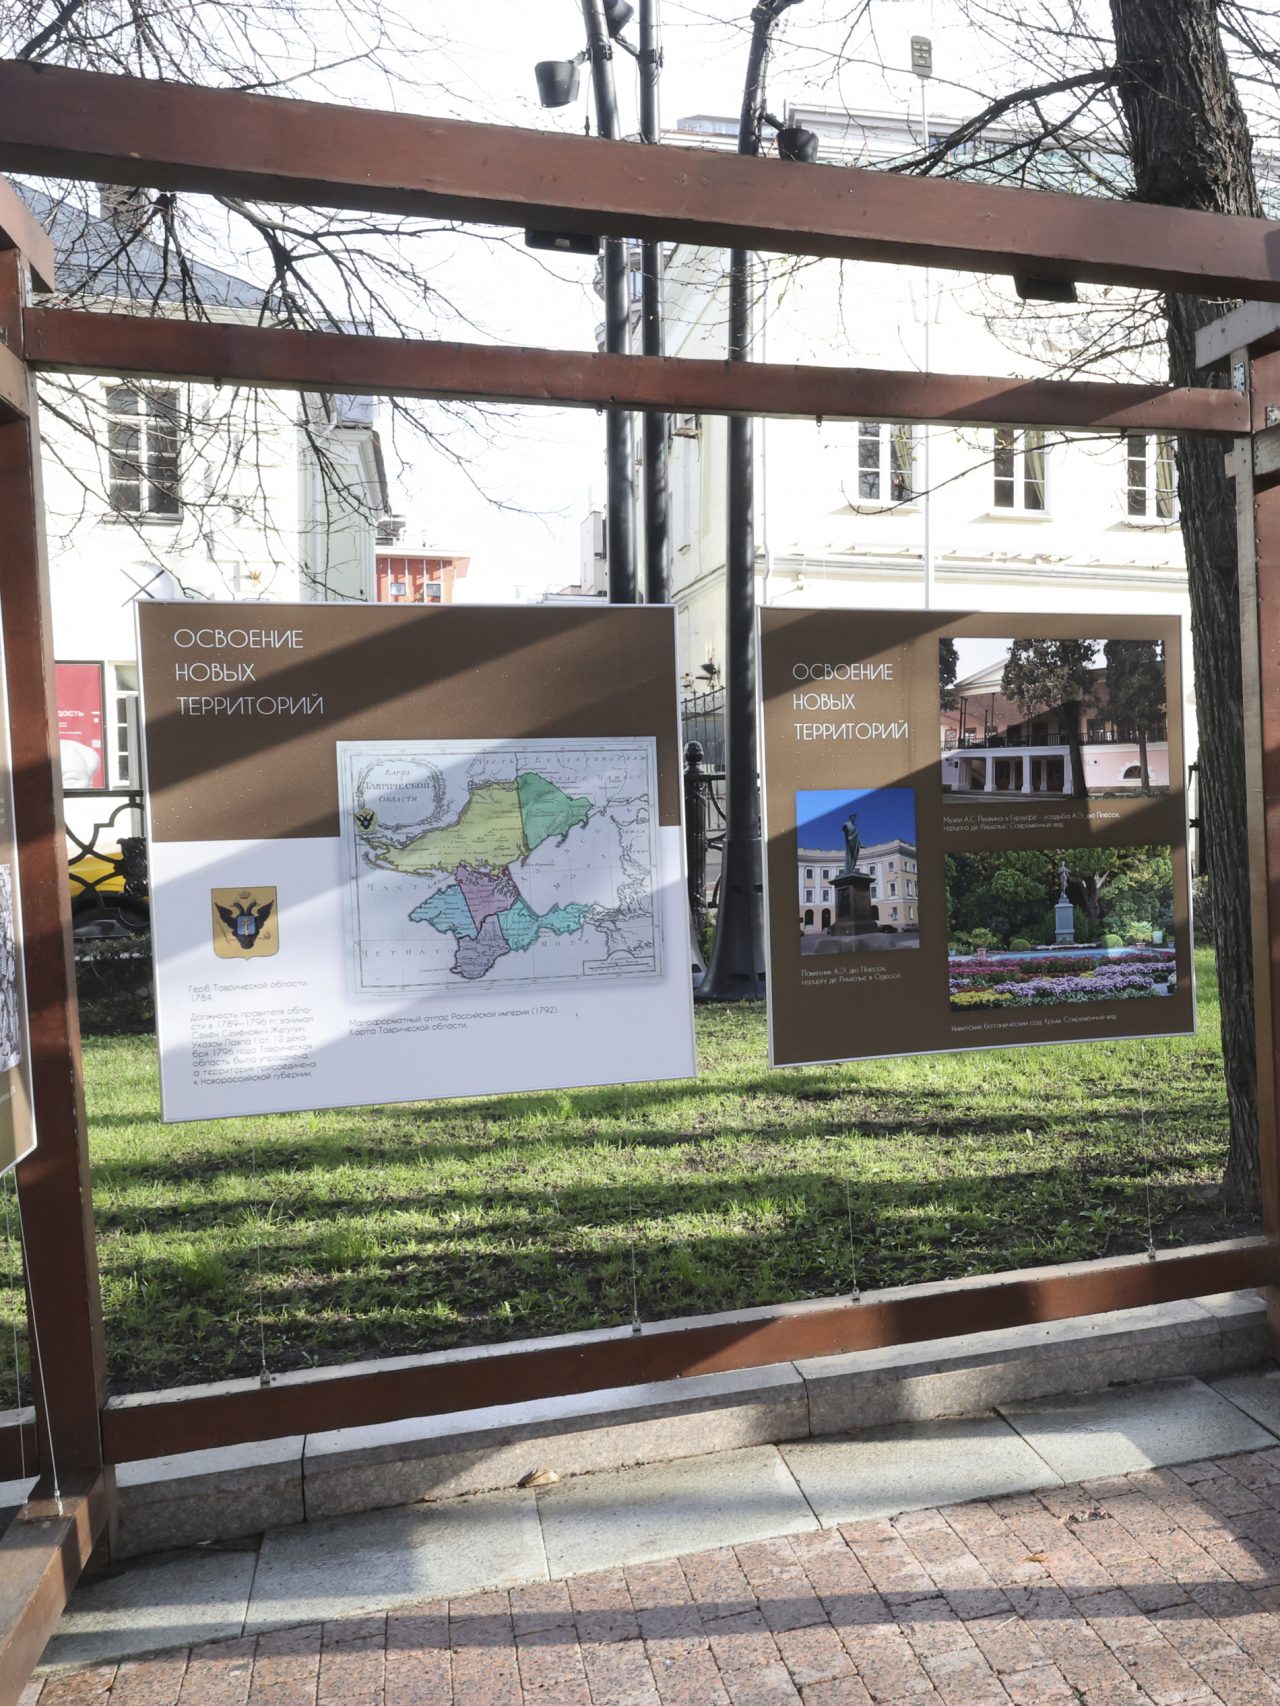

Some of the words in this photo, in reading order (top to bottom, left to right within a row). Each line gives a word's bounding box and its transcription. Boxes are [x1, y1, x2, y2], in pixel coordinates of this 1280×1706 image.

[174, 629, 304, 648] ОСВОЕНИЕ
[175, 662, 256, 682] НОВЫХ
[792, 662, 894, 681] ОСВОЕНИЕ
[176, 692, 324, 715] ТЕРРИТОРИЙ
[792, 693, 856, 711] НОВЫХ
[793, 720, 909, 741] ТЕРРИТОРИЙ
